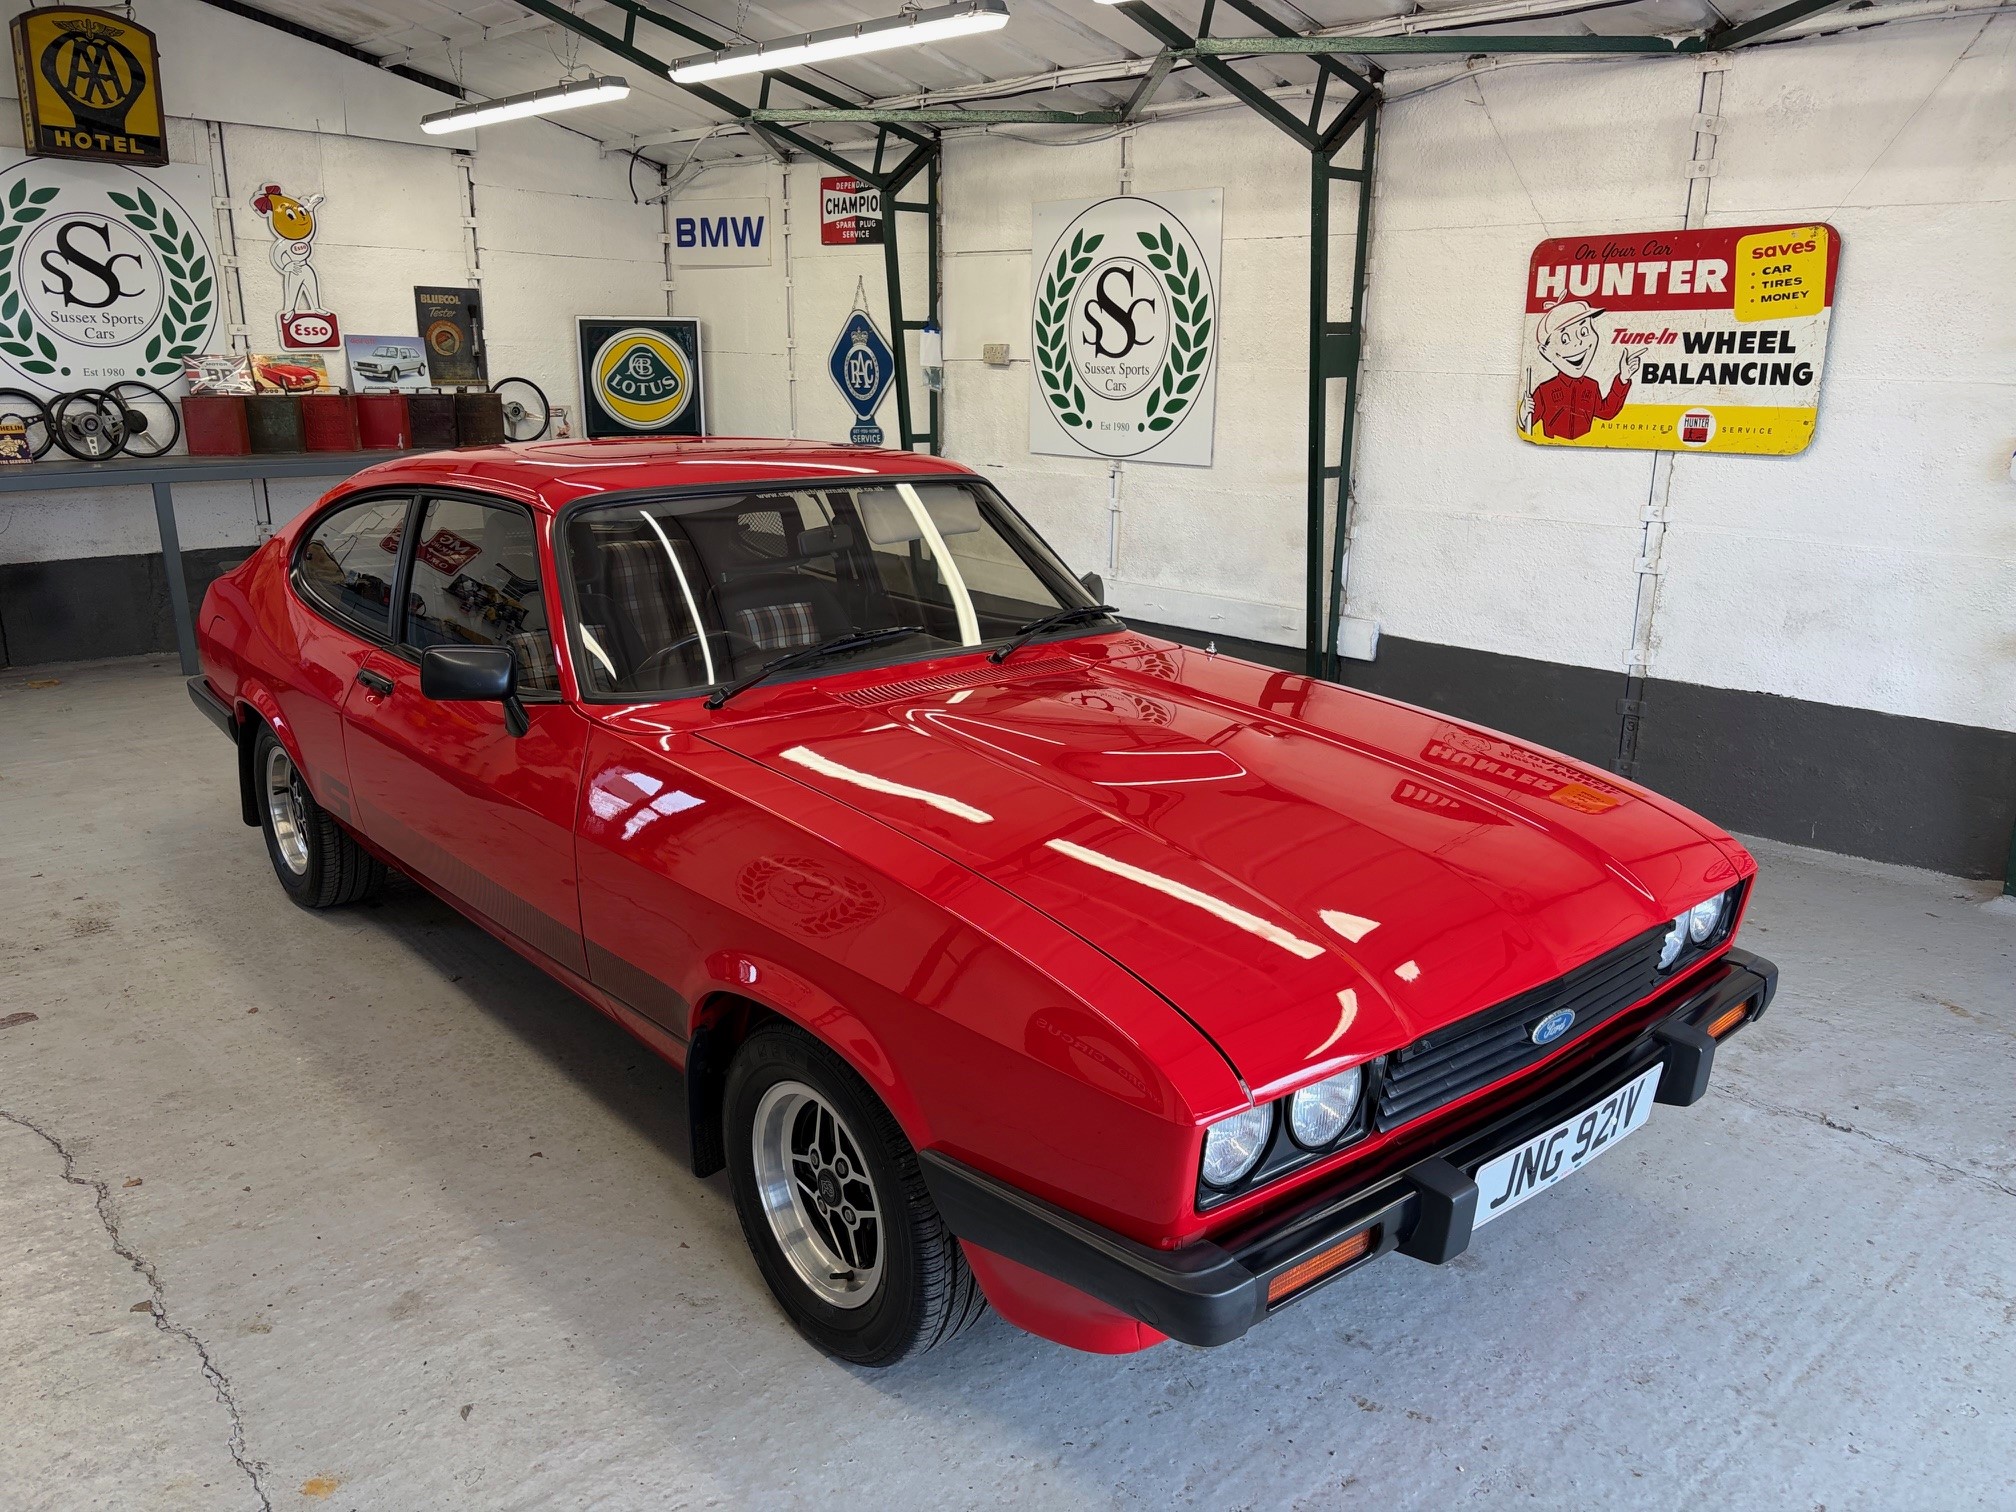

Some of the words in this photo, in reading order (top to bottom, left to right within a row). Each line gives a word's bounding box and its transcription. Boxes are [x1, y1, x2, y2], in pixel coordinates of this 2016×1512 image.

[67, 39, 125, 105] AA
[54, 130, 145, 154] HOTEL
[676, 215, 764, 248] BMW
[836, 221, 856, 229] SPARK
[860, 220, 876, 228] PLUG
[843, 230, 870, 238] SERVICE
[1575, 243, 1597, 260] On
[1601, 241, 1636, 263] Your
[1642, 239, 1673, 256] Car
[1752, 240, 1816, 260] saves
[1535, 258, 1728, 298] HUNTER
[1762, 264, 1792, 275] CAR
[1761, 277, 1803, 289] TIRES
[420, 294, 461, 305] BLUECOL
[1760, 290, 1810, 303] MONEY
[51, 311, 97, 324] Sussex
[102, 312, 144, 327] Sports
[428, 306, 456, 318] Tester
[84, 327, 115, 340] Cars
[294, 324, 328, 336] Esso
[1611, 328, 1679, 345] Tune-In
[1682, 330, 1796, 354] WHEEL
[83, 368, 98, 377] Est
[102, 368, 125, 377] 1980
[850, 351, 874, 389] RAC
[1084, 362, 1116, 375] Sussex
[1118, 362, 1150, 379] Sports
[1641, 361, 1814, 386] BALANCING
[610, 374, 676, 396] LOTUS
[1105, 379, 1127, 392] Cars
[1100, 421, 1111, 431] Est
[1113, 421, 1130, 432] 1980
[1600, 422, 1673, 432] AUTHORIZED
[1684, 418, 1710, 428] HUNTER
[1722, 426, 1773, 435] SERVICE
[852, 434, 881, 443] SERVICE
[1543, 1018, 1568, 1038] Ford
[1490, 1127, 1569, 1210] JNG
[1571, 1078, 1646, 1163] 921V
